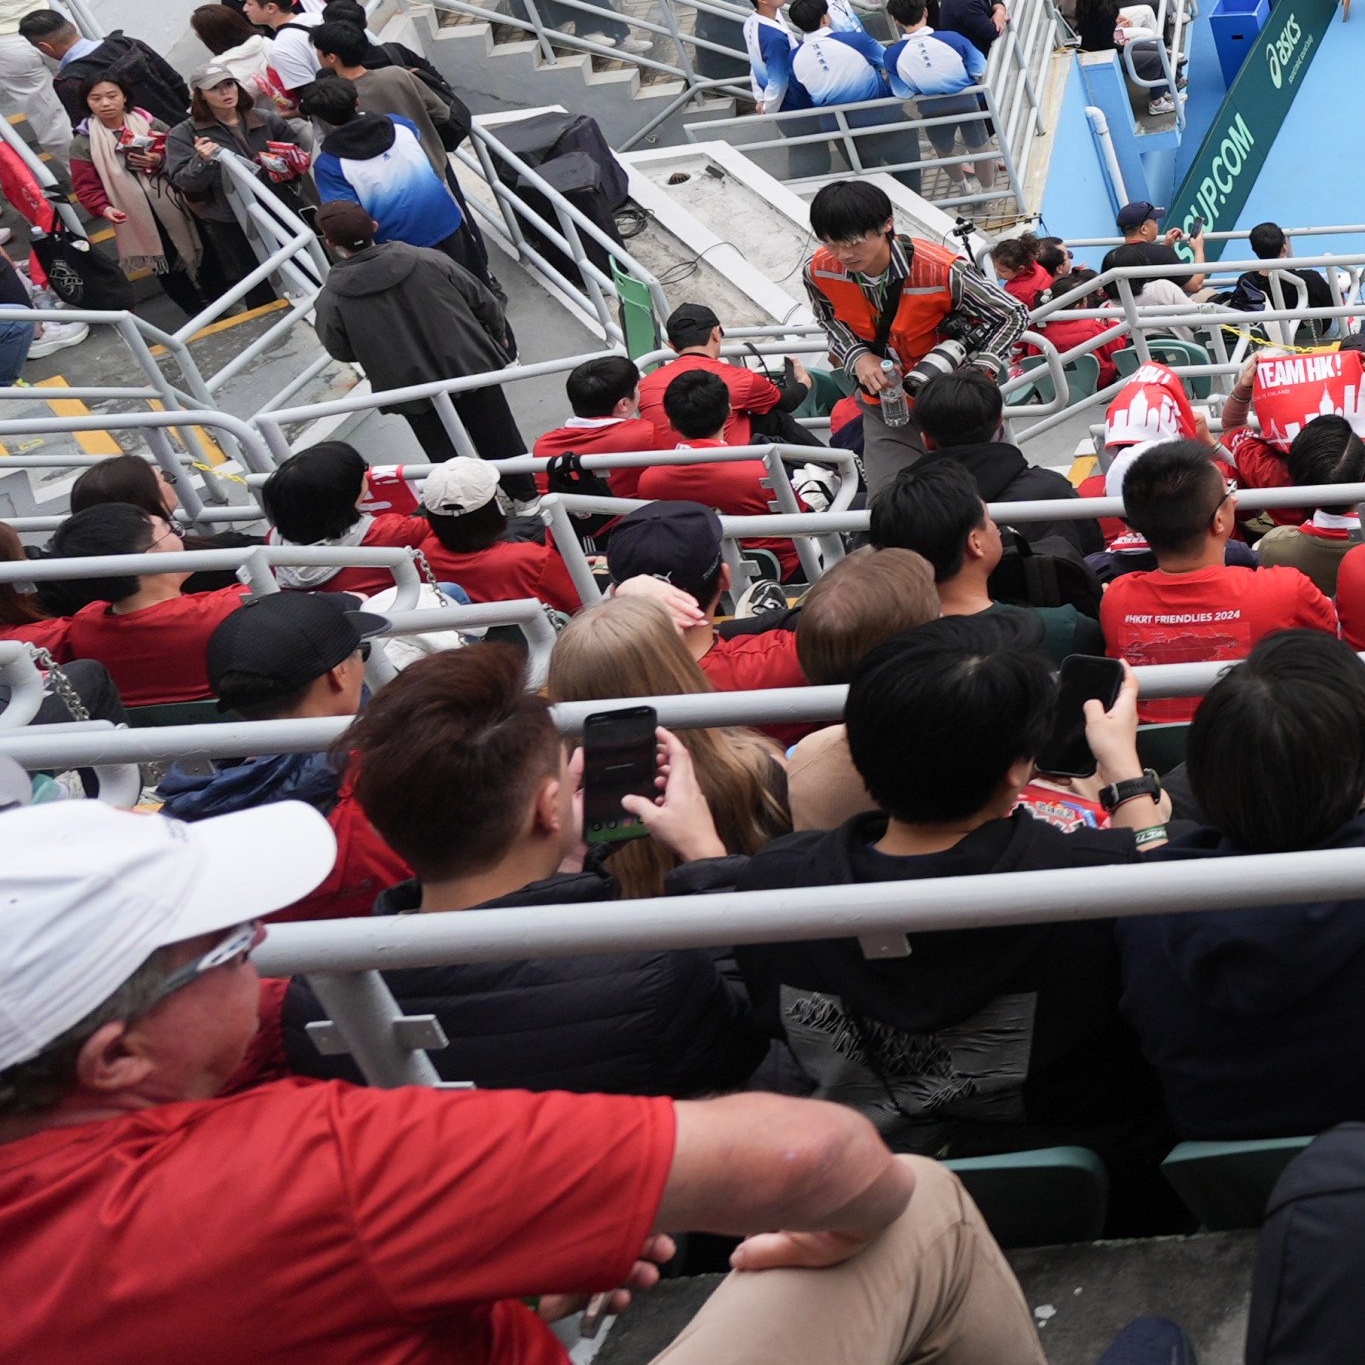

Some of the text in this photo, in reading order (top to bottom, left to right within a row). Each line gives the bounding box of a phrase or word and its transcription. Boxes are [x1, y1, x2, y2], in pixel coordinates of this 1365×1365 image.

[1277, 13, 1301, 65] asics
[1258, 359, 1306, 389] TEAM
[1125, 610, 1241, 624] #HKRT FRIENDLIES 2024
